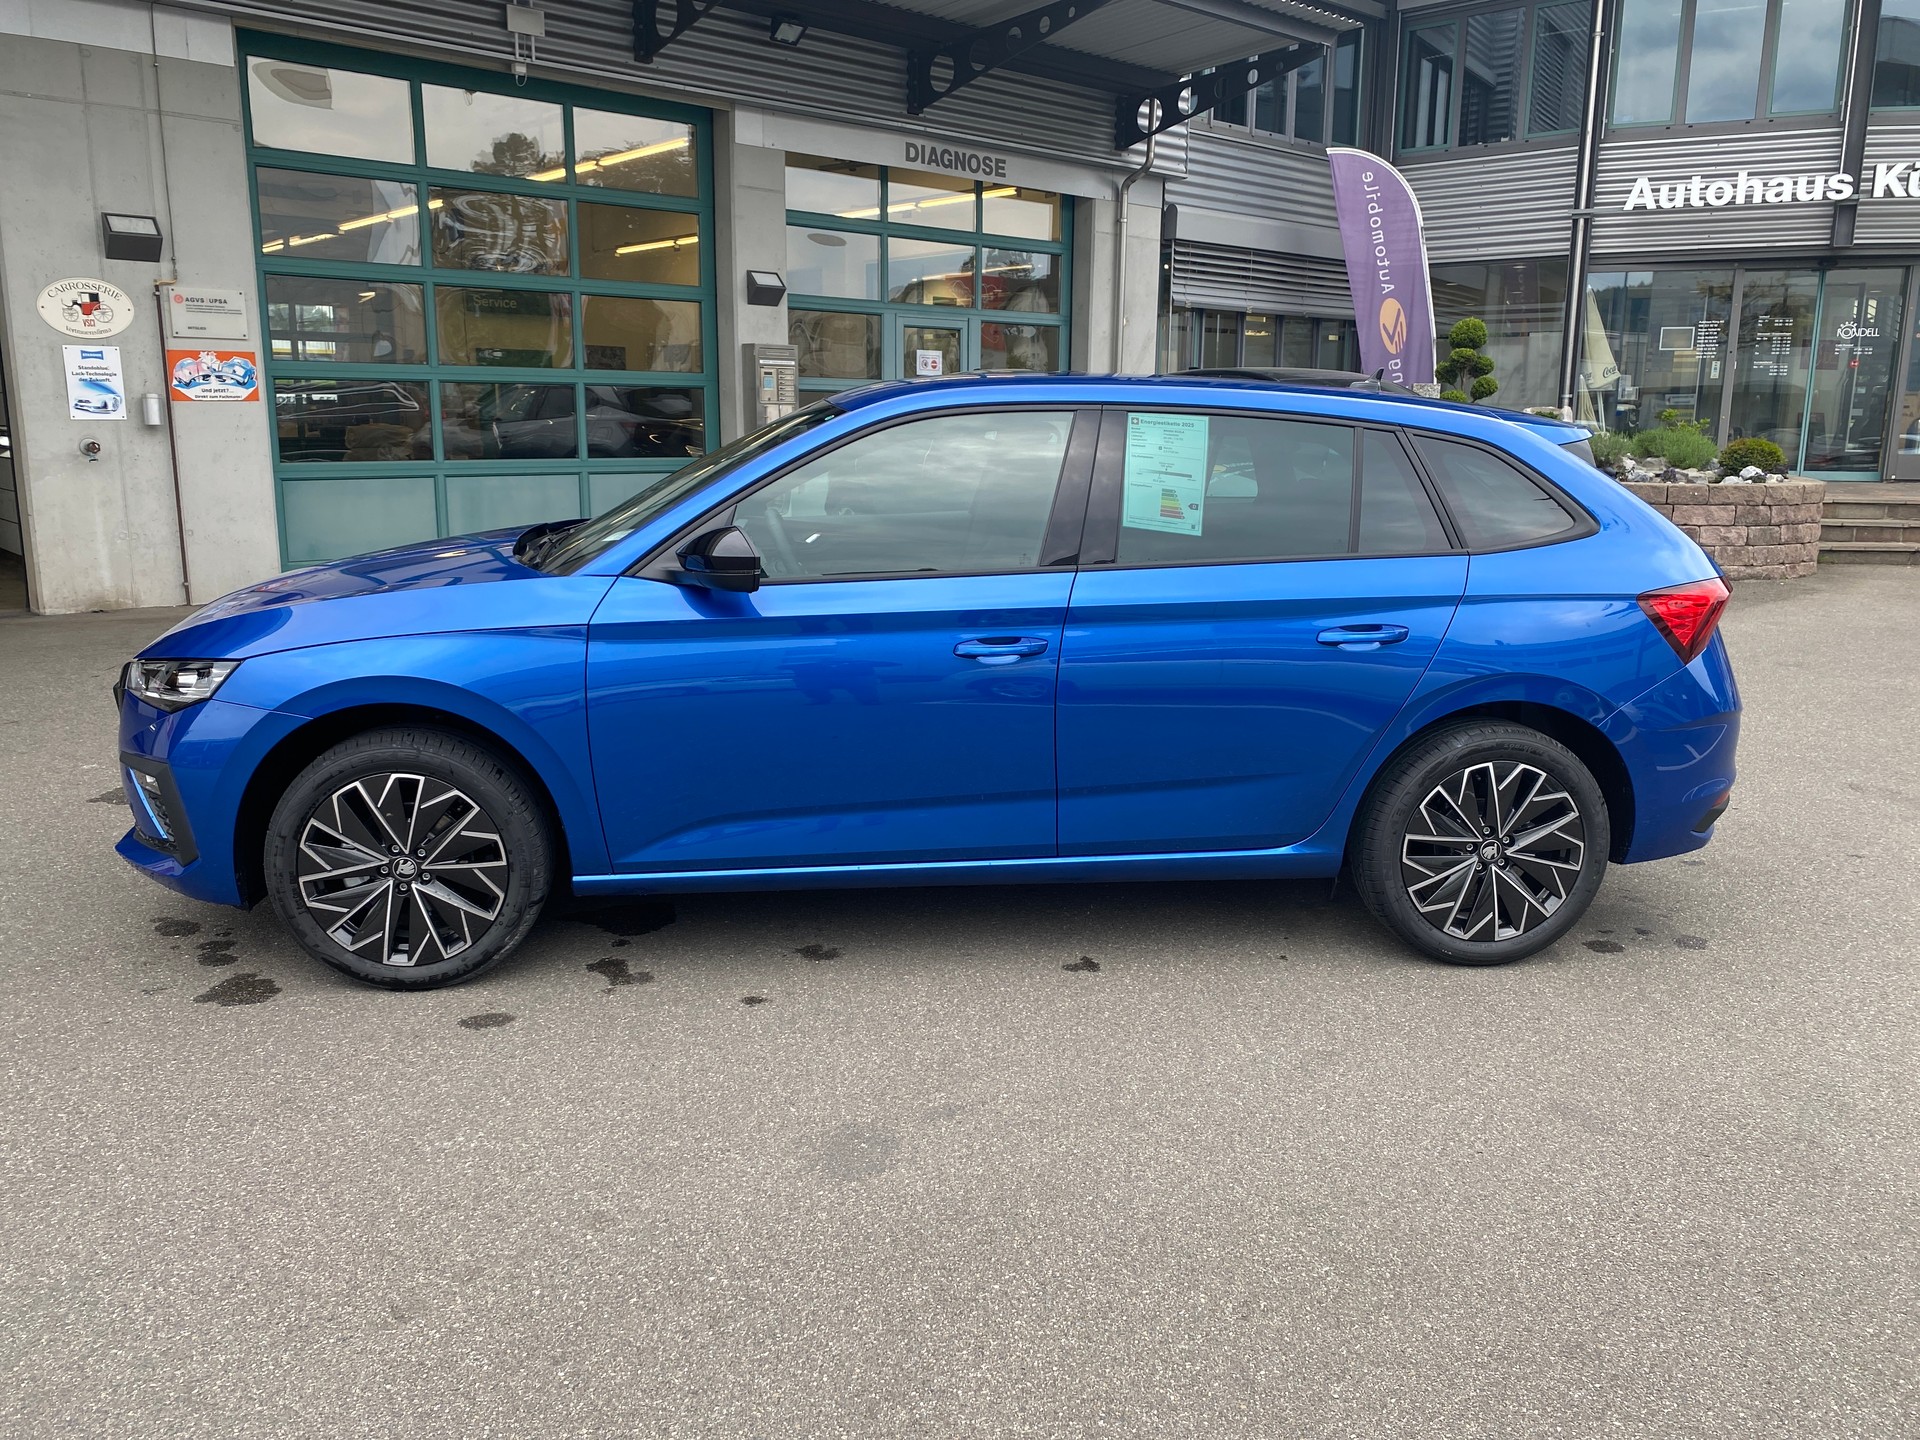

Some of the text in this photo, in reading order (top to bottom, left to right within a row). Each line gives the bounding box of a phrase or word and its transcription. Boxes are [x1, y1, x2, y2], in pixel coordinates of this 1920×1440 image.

[905, 141, 1006, 178] DIAGNOSE
[1623, 170, 1854, 211] Autohaus
[47, 282, 122, 301] CARROSSERIE
[473, 295, 517, 309] Service
[1836, 321, 1880, 339] RONDELL
[1603, 366, 1616, 378] Coca
